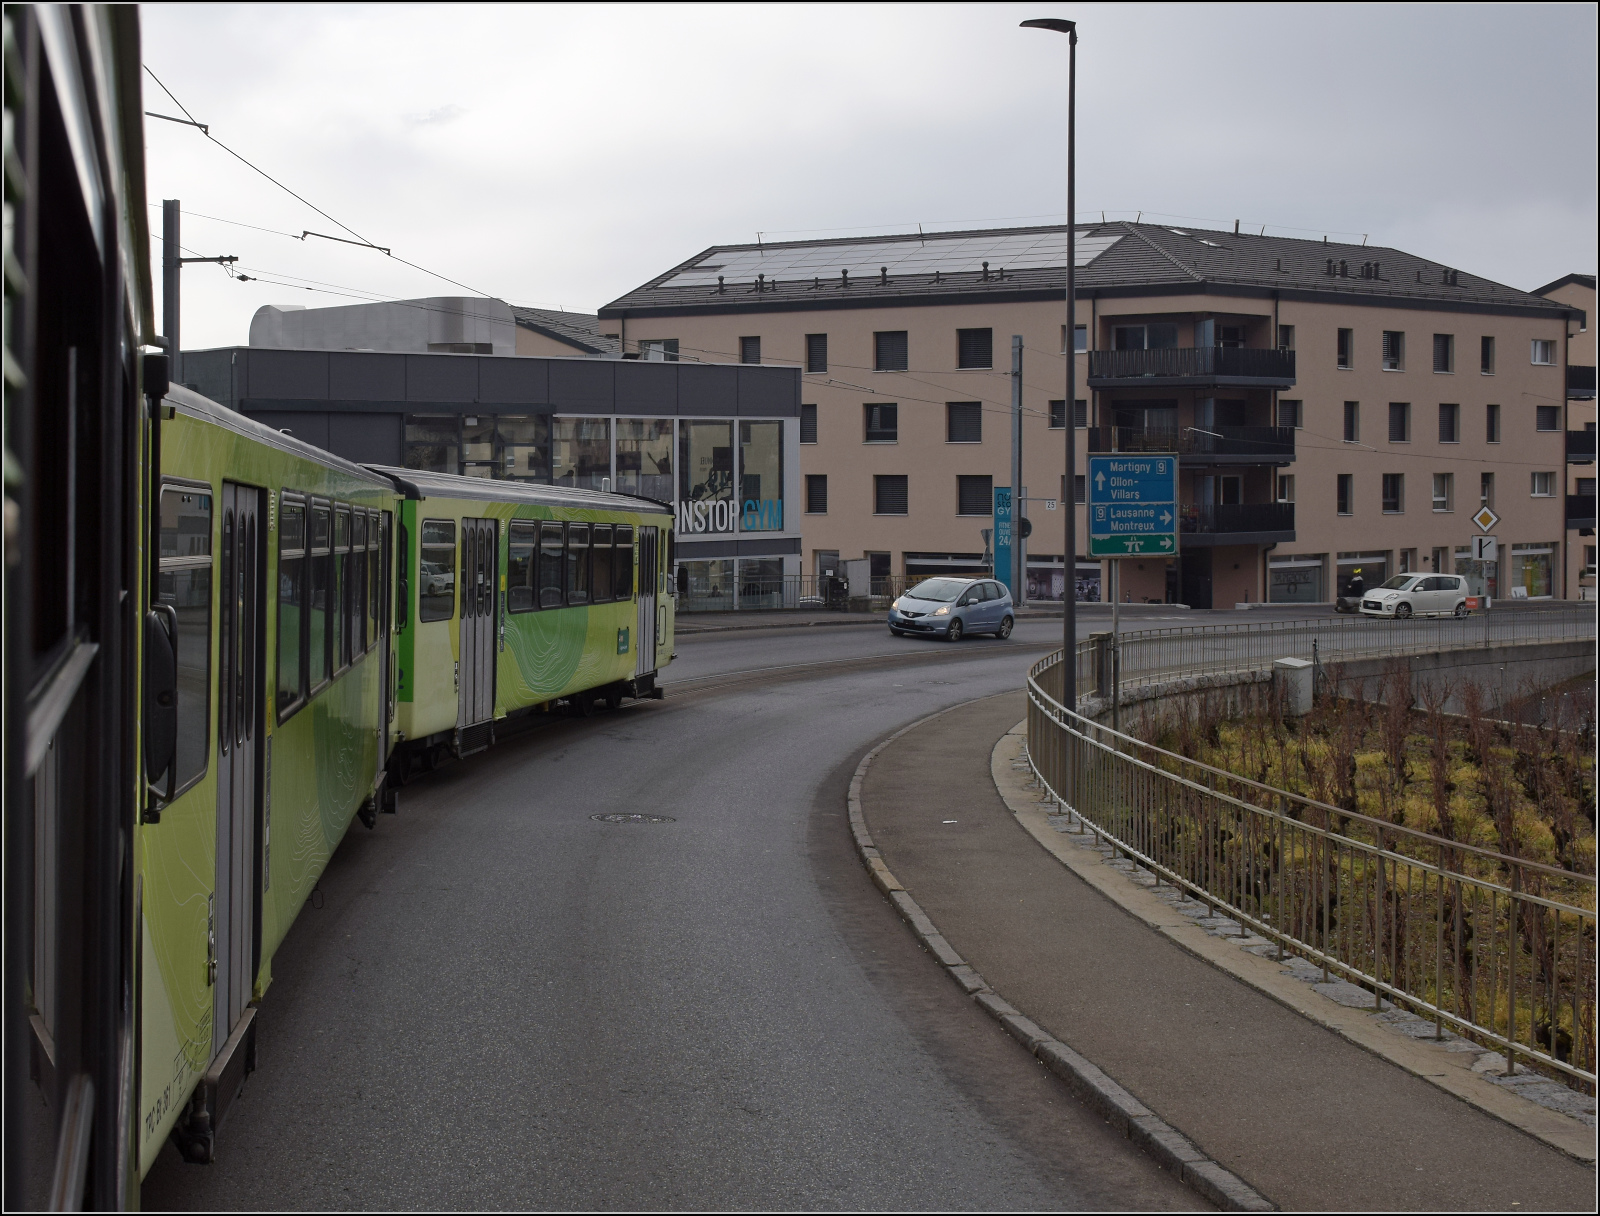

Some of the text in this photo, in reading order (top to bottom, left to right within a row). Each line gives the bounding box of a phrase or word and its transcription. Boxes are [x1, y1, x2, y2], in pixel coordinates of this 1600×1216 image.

[1110, 462, 1151, 474] Martigny
[1110, 477, 1139, 487] Ollon-
[1110, 489, 1140, 500] Villars
[1047, 501, 1055, 509] 25
[743, 499, 782, 530] GYM
[1110, 508, 1155, 519] Lausanne
[1110, 521, 1155, 531] Montreux
